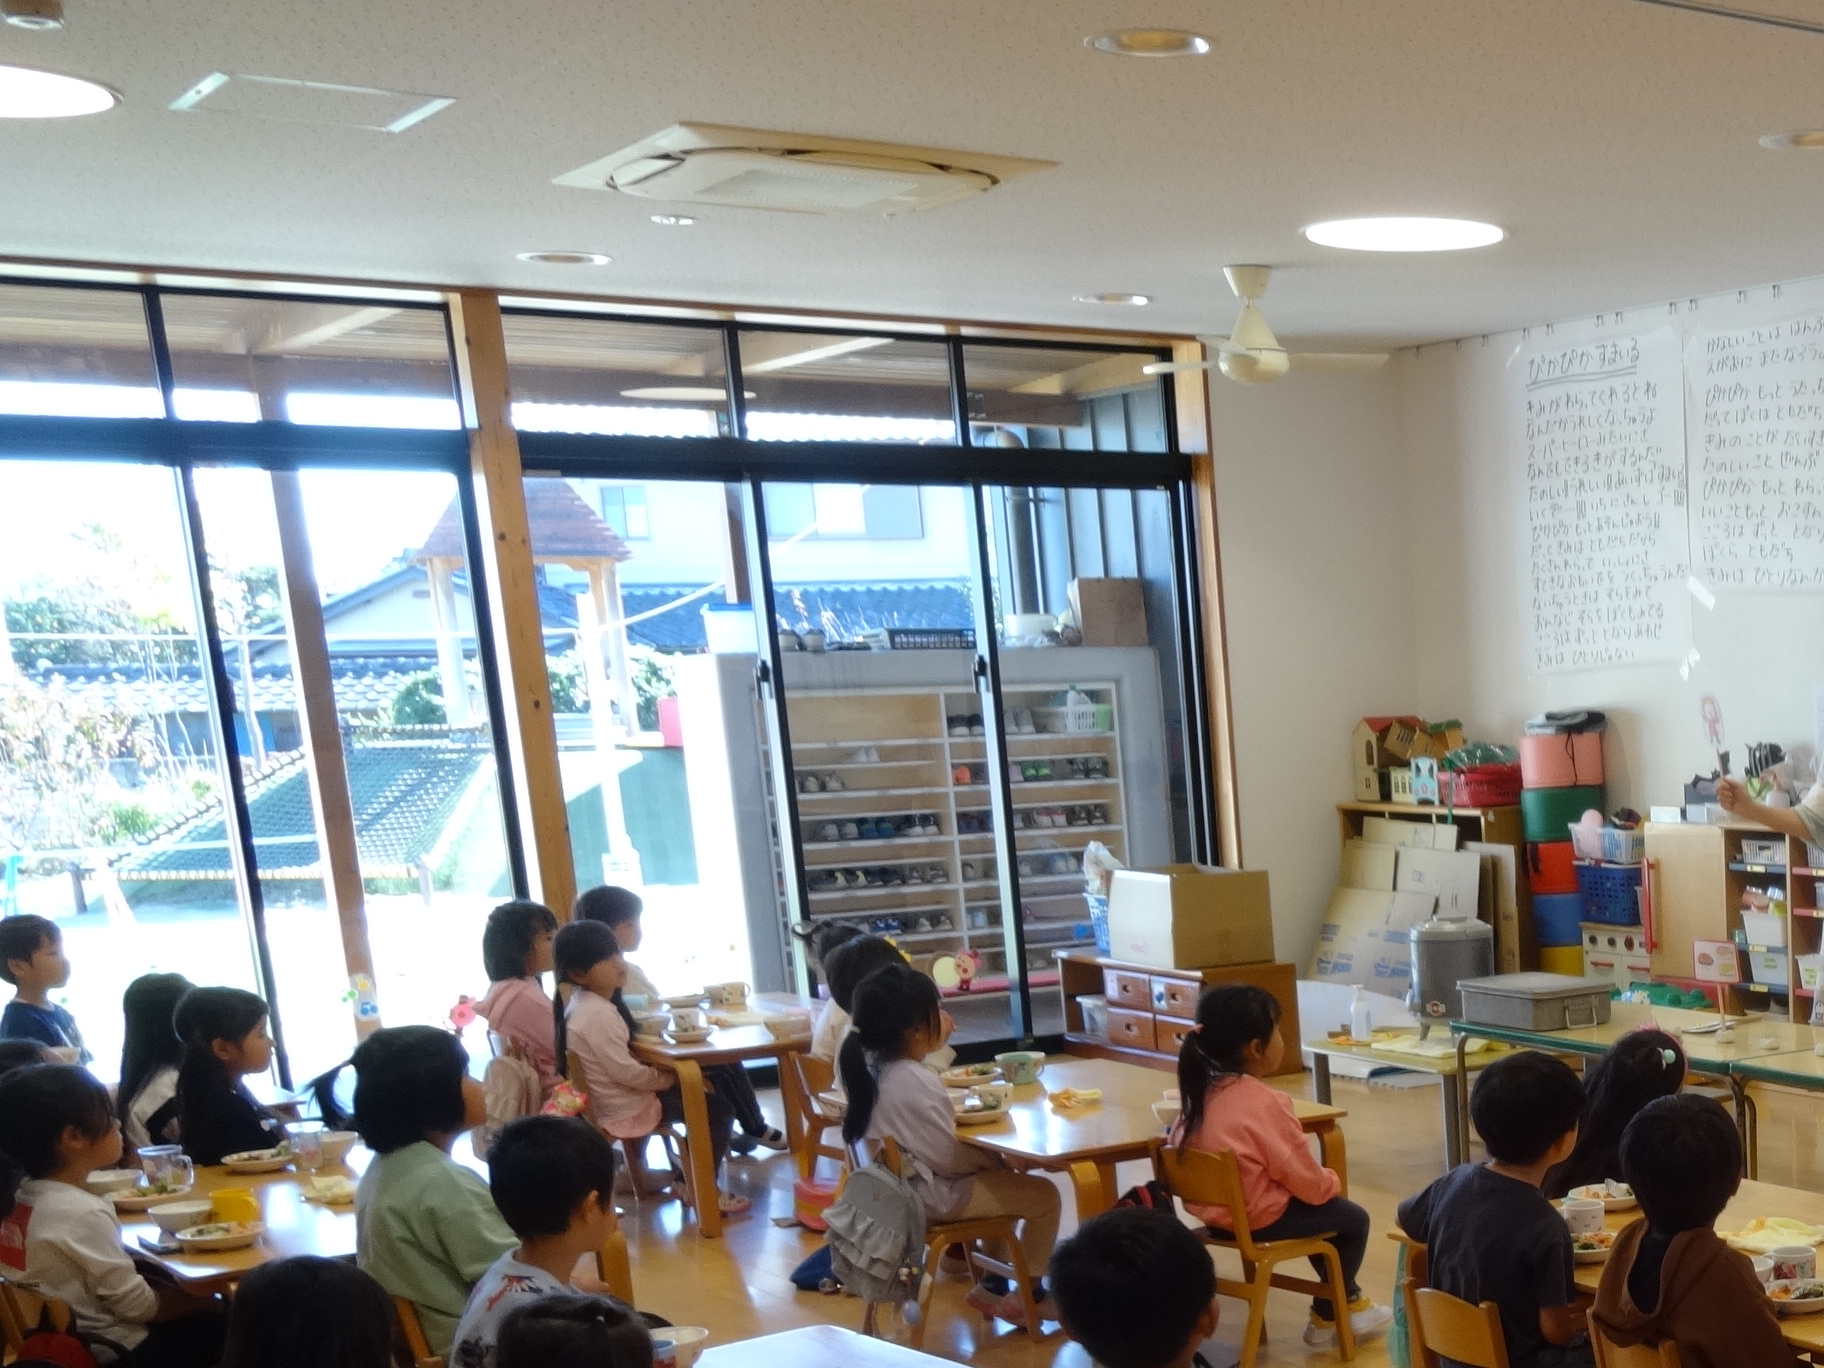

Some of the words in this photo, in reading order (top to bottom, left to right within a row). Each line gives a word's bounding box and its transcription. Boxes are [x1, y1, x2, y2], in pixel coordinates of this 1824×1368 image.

[1529, 349, 1592, 384] ぴかぴか
[1596, 337, 1640, 368] すまいる
